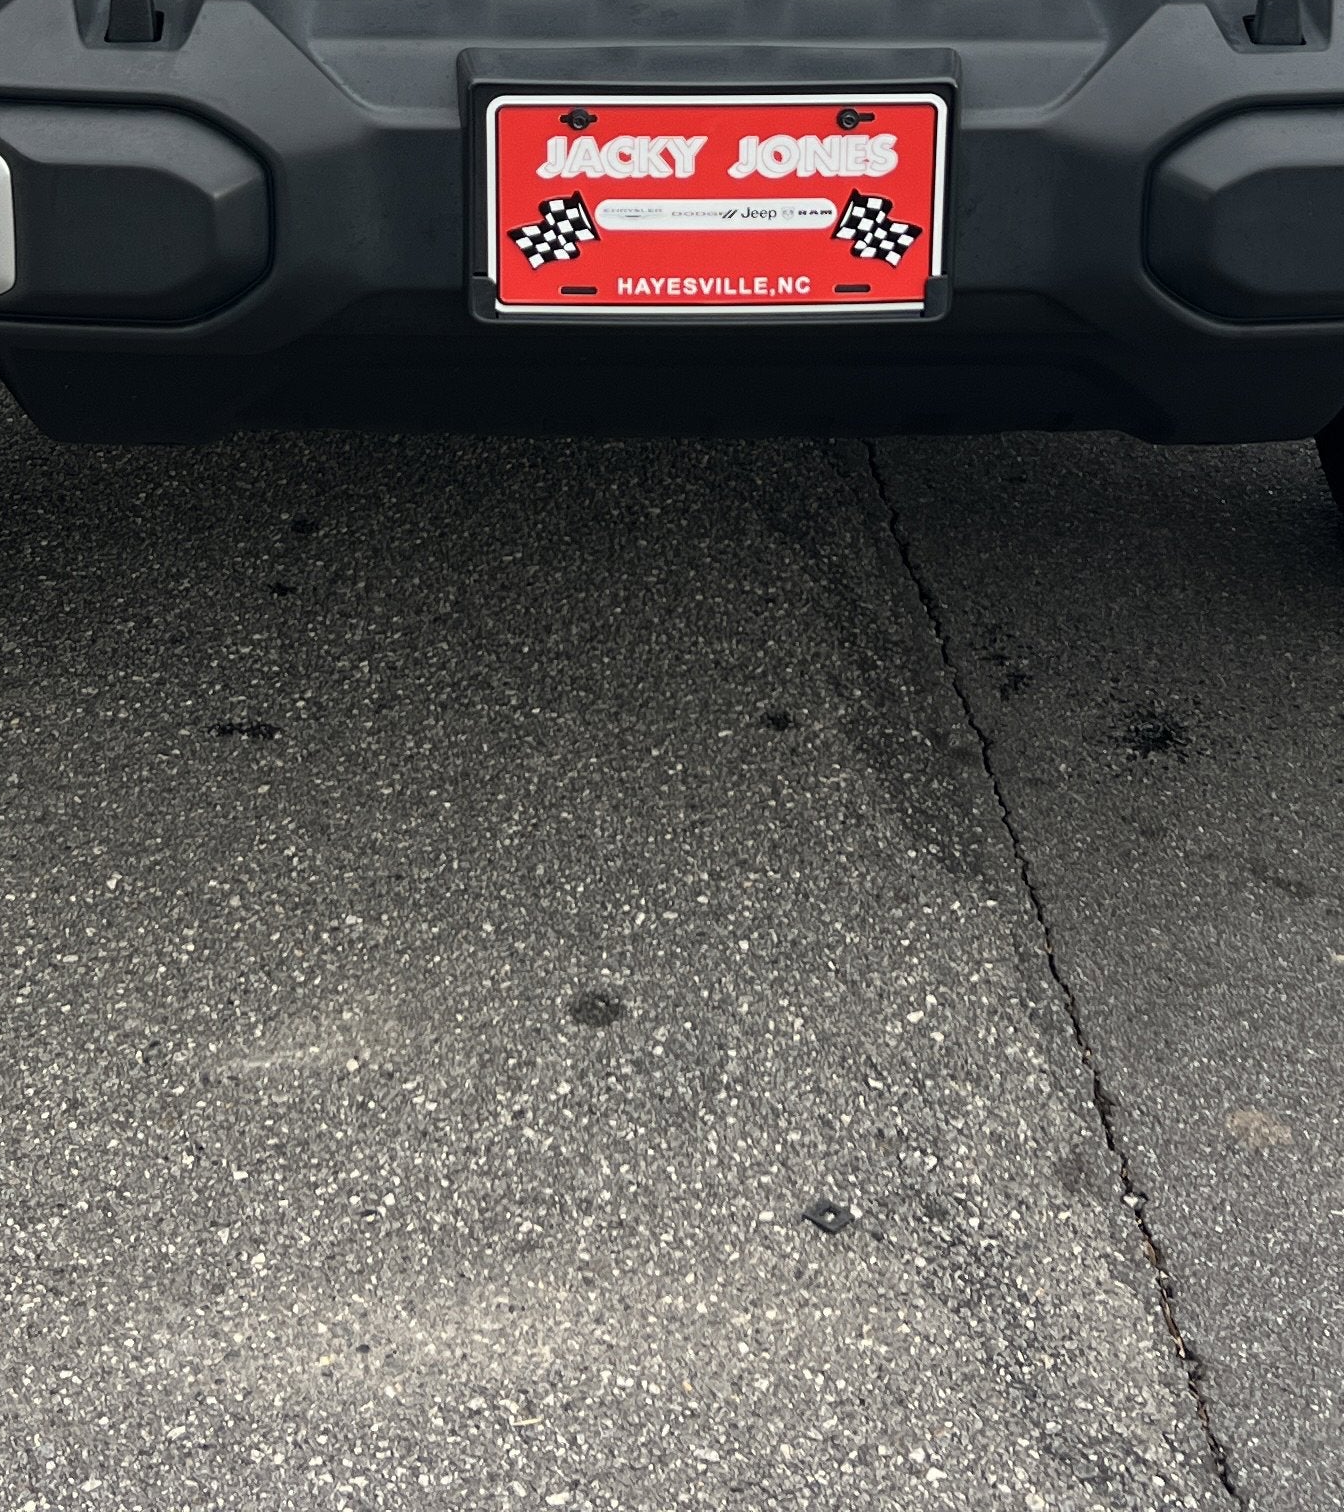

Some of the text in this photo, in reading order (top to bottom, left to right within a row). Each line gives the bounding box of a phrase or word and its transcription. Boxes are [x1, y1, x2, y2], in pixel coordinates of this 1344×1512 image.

[536, 134, 899, 179] JACKY JONES
[741, 207, 777, 220] Jeep
